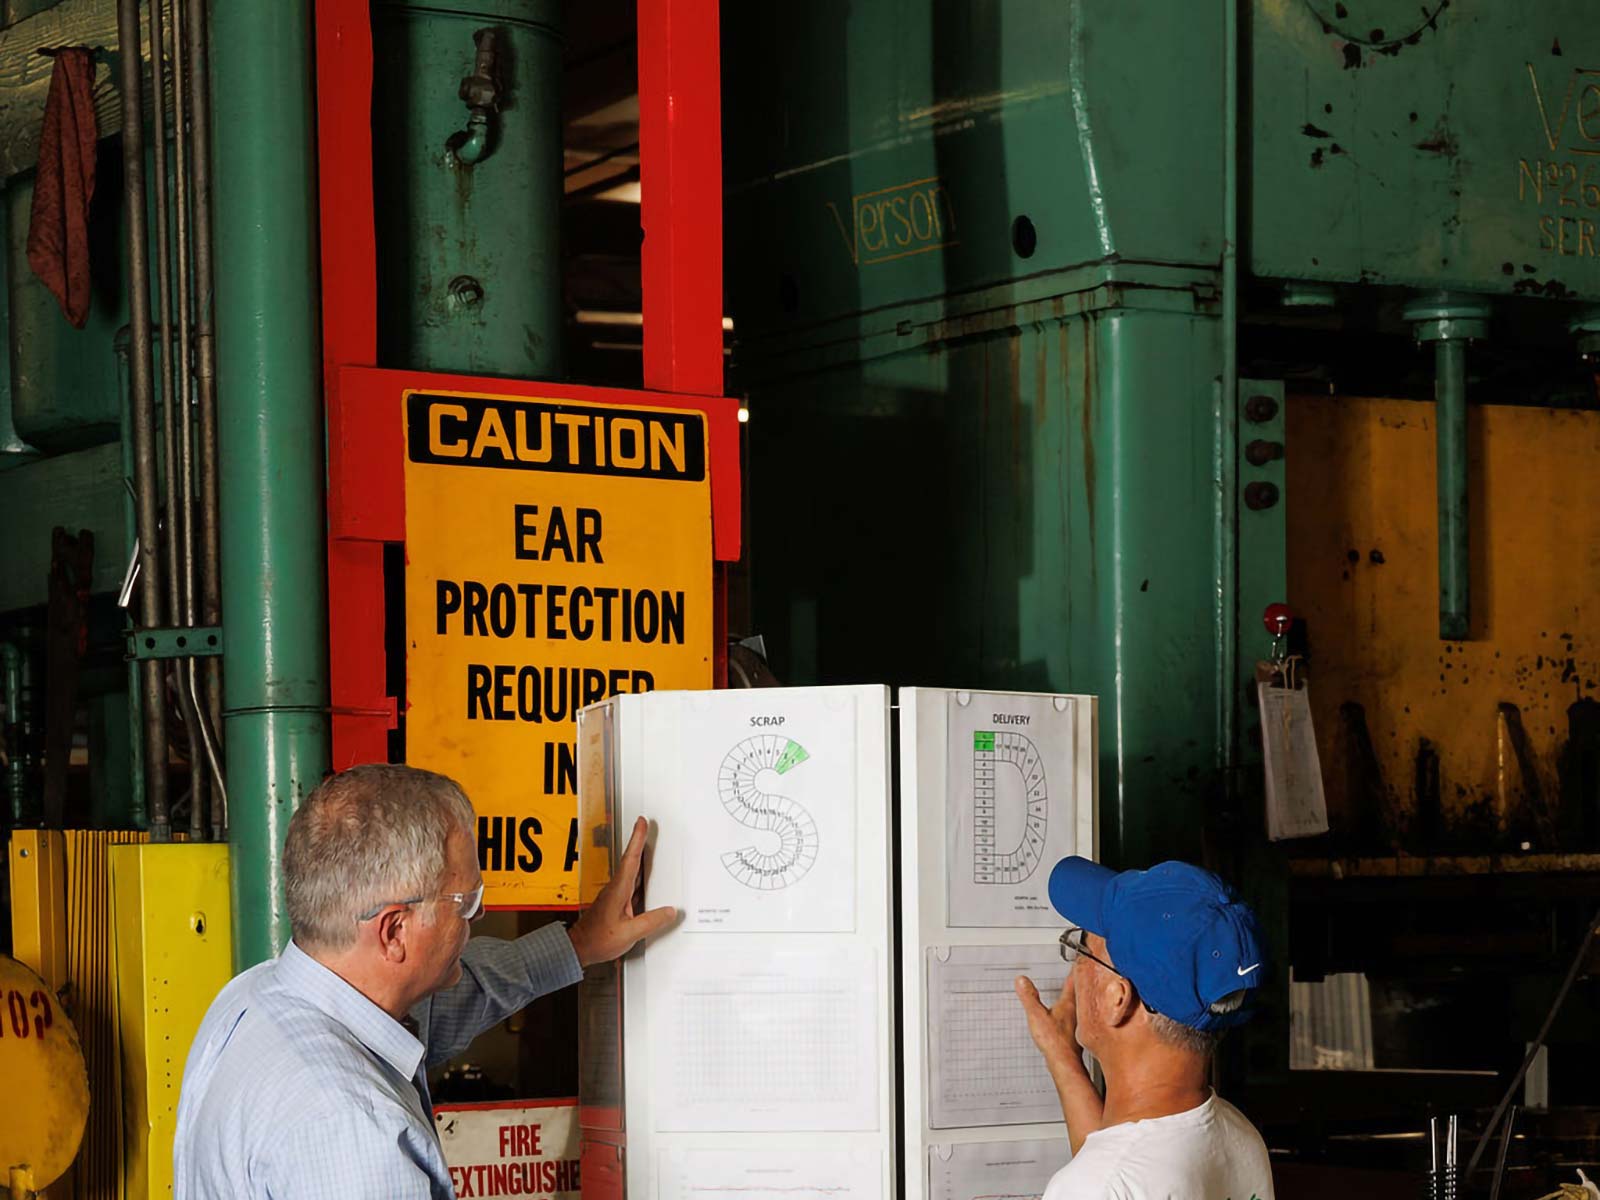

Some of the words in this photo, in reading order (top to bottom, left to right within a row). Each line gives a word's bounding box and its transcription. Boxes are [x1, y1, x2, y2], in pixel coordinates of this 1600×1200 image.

[1539, 214, 1600, 257] SER
[428, 402, 686, 473] CAUTION
[514, 503, 604, 564] EAR
[436, 579, 685, 644] PROTECTION
[749, 716, 786, 727] SCRAP
[992, 713, 1031, 725] DELIVERY
[543, 742, 578, 795] IN
[477, 815, 543, 873] HIS
[0, 989, 53, 1040] OP
[499, 1124, 542, 1158] FIRE
[448, 1159, 581, 1199] EXTINGUISHE
